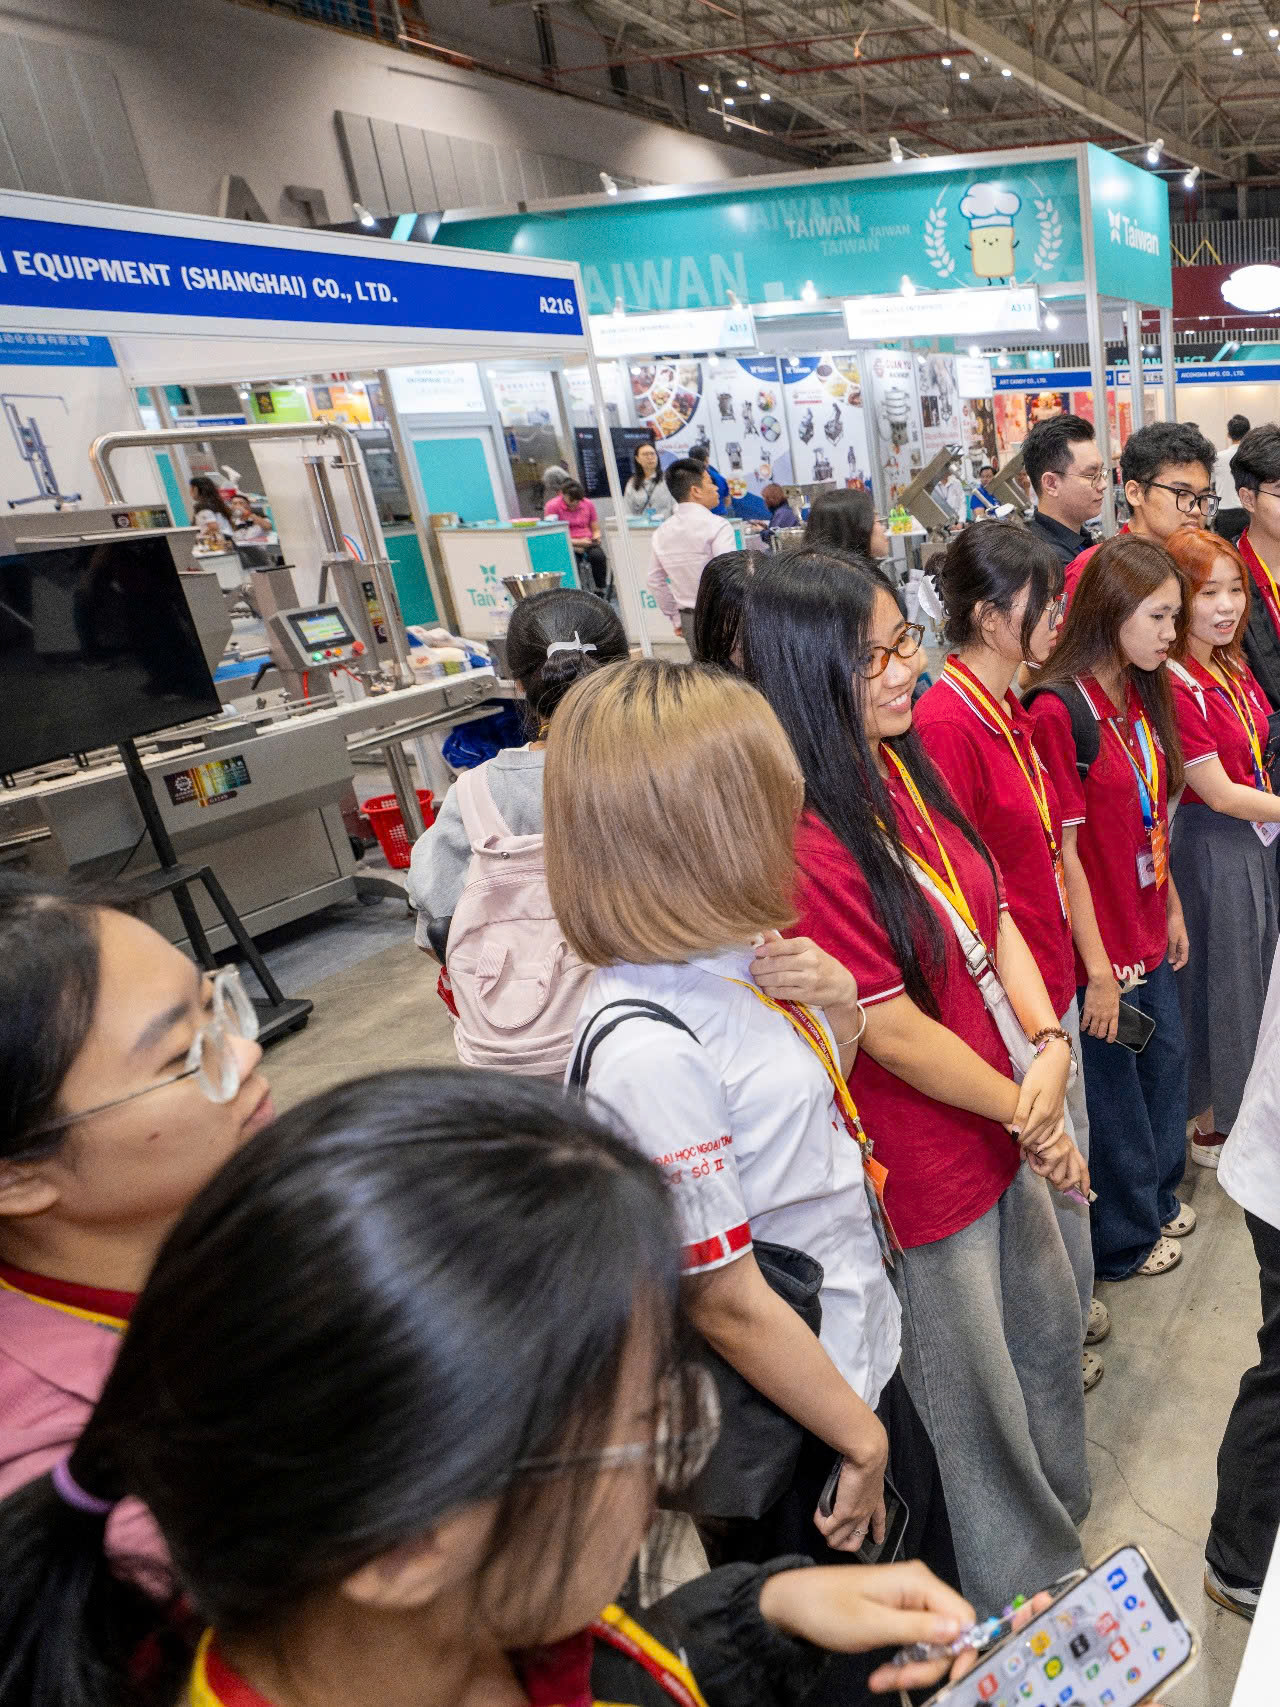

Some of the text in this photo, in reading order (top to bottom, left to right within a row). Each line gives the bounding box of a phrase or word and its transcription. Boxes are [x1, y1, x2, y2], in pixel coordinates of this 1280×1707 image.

[784, 215, 862, 240] TAIWAN
[820, 238, 881, 257] TAIWAN
[1121, 215, 1160, 257] Taiwan
[12, 250, 171, 288] EQUIPMENT
[180, 266, 307, 299] (SHANGHAI)
[313, 277, 353, 304] CO.,
[355, 281, 398, 303] LTD.
[540, 296, 575, 315] A216
[583, 251, 750, 315] AIWAN
